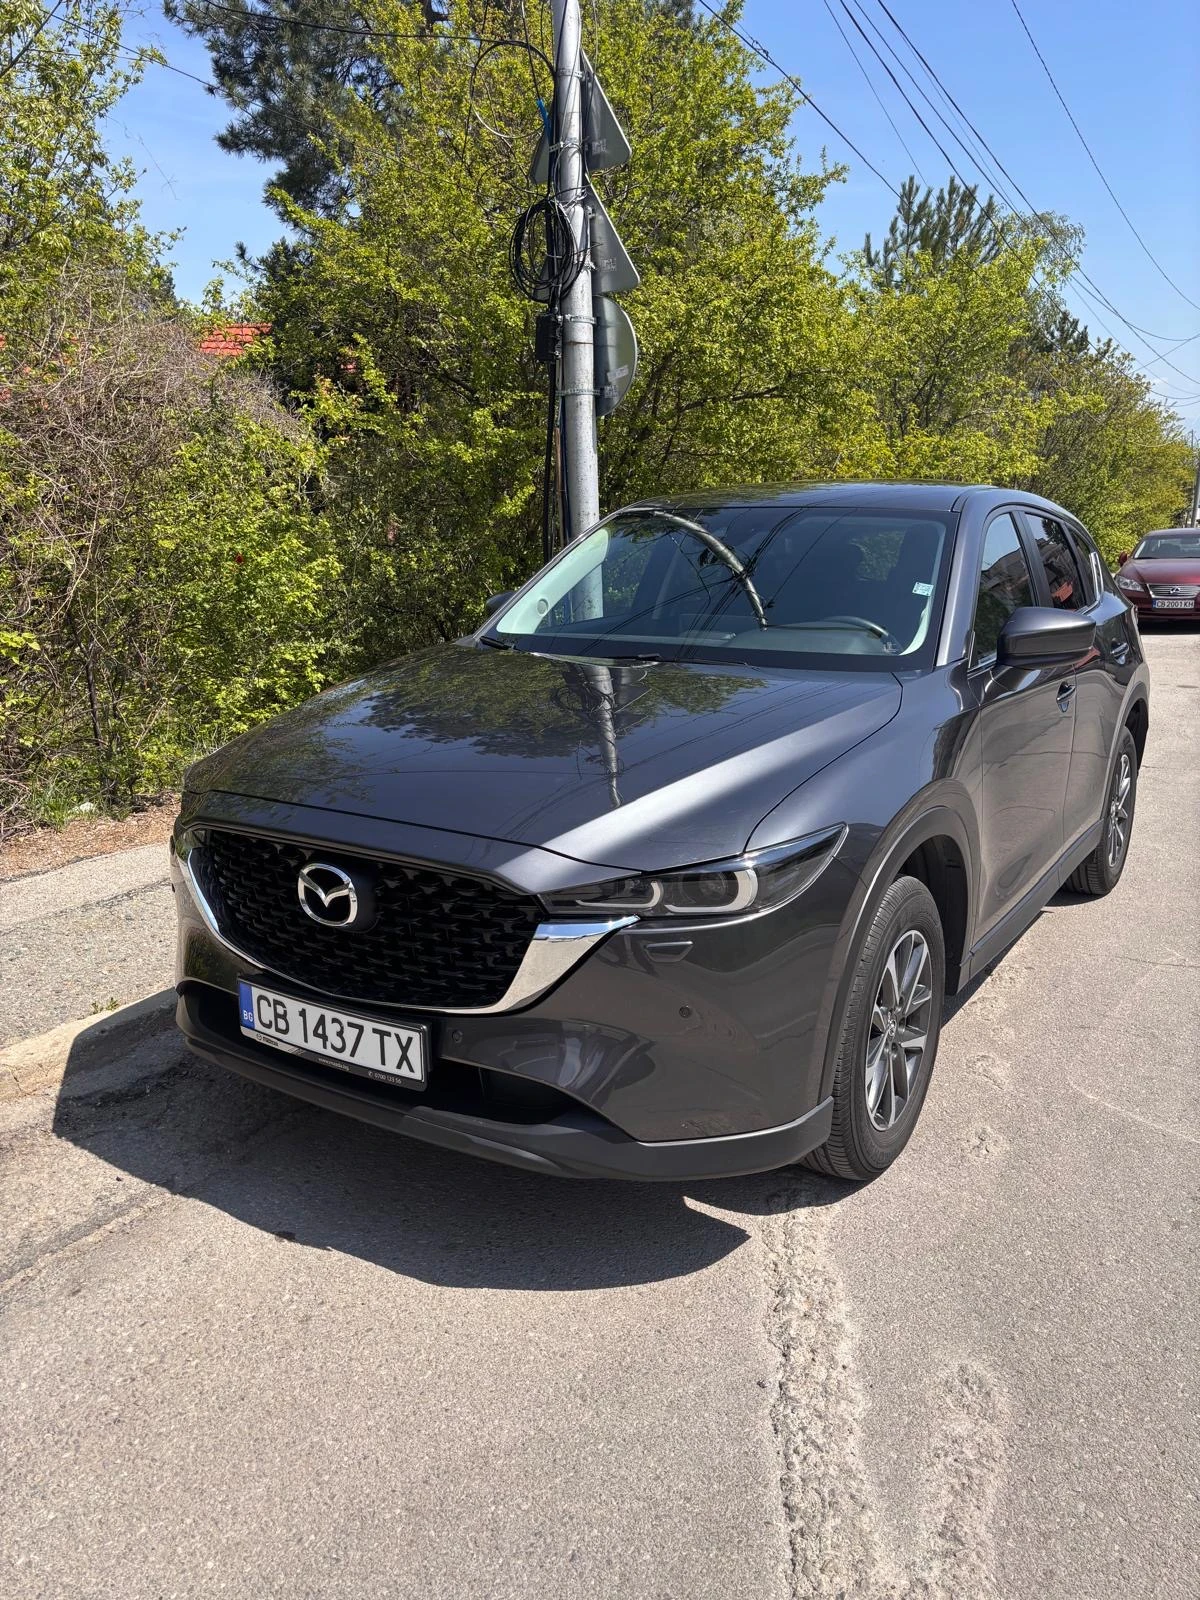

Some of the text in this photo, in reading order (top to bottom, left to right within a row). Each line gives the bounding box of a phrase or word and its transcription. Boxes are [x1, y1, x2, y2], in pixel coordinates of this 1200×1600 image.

[1157, 600, 1165, 608] CB
[1166, 600, 1182, 608] 2001
[1184, 600, 1194, 608] KH
[243, 1010, 254, 1022] BG
[256, 994, 415, 1073] CB 1437 TX
